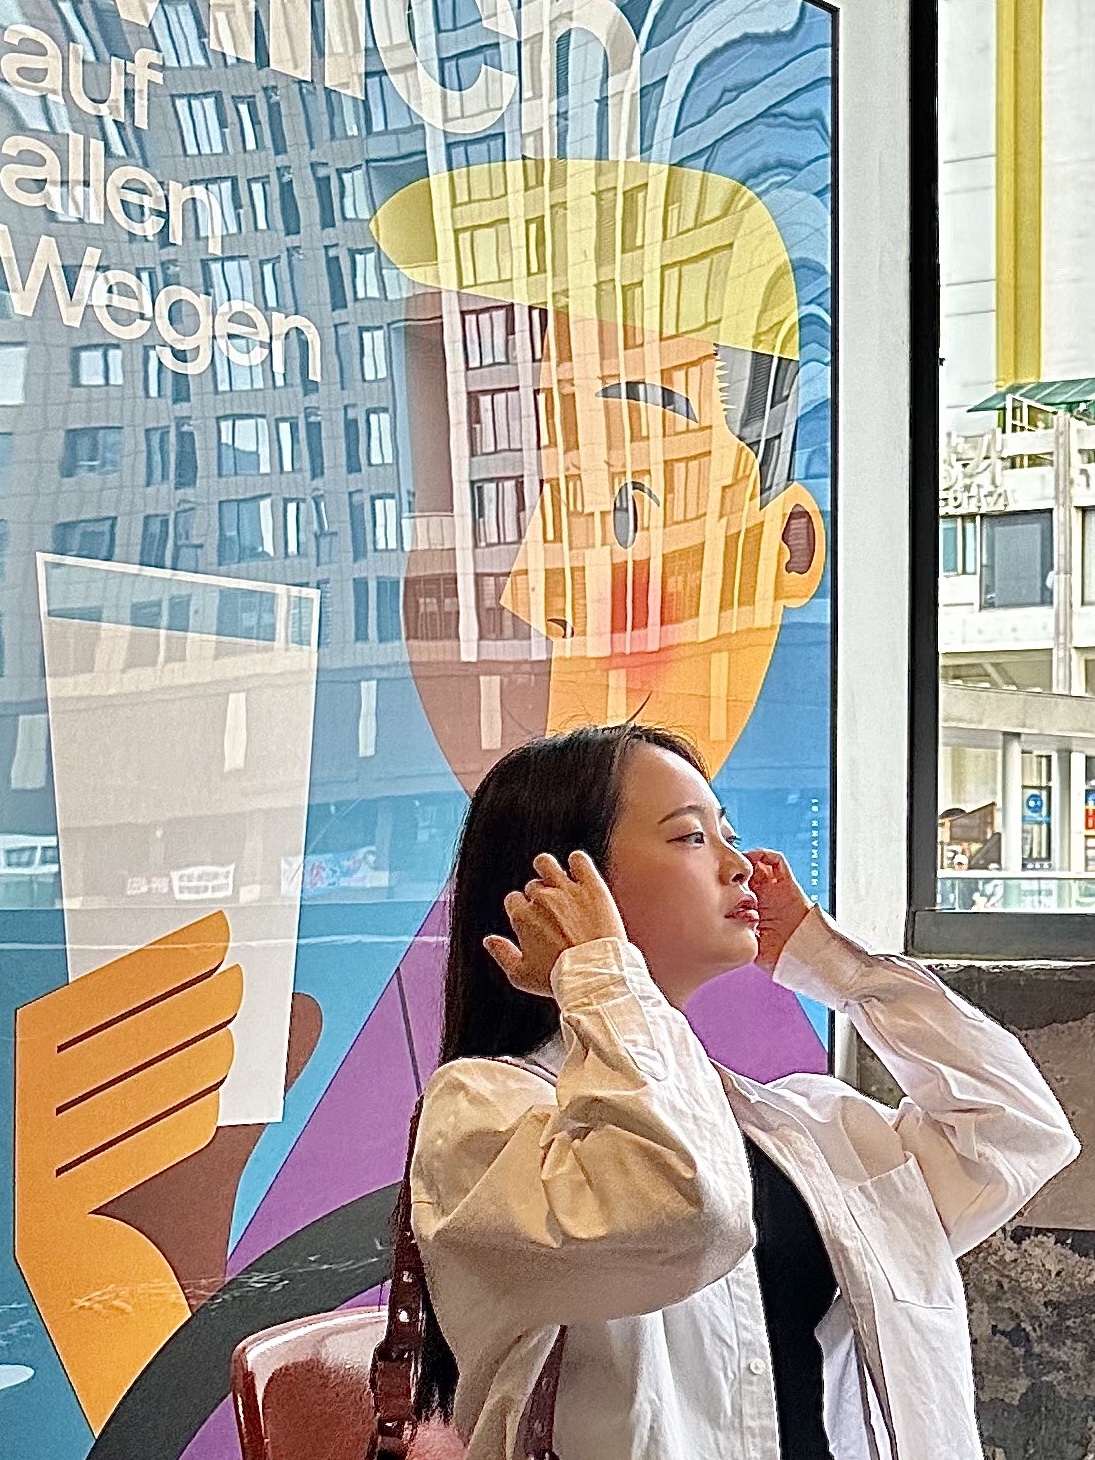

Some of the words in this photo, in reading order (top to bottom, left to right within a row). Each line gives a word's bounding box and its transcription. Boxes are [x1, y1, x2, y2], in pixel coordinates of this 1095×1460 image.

[0, 24, 164, 130] auf
[0, 131, 222, 257] allen
[0, 223, 322, 383] Wegen
